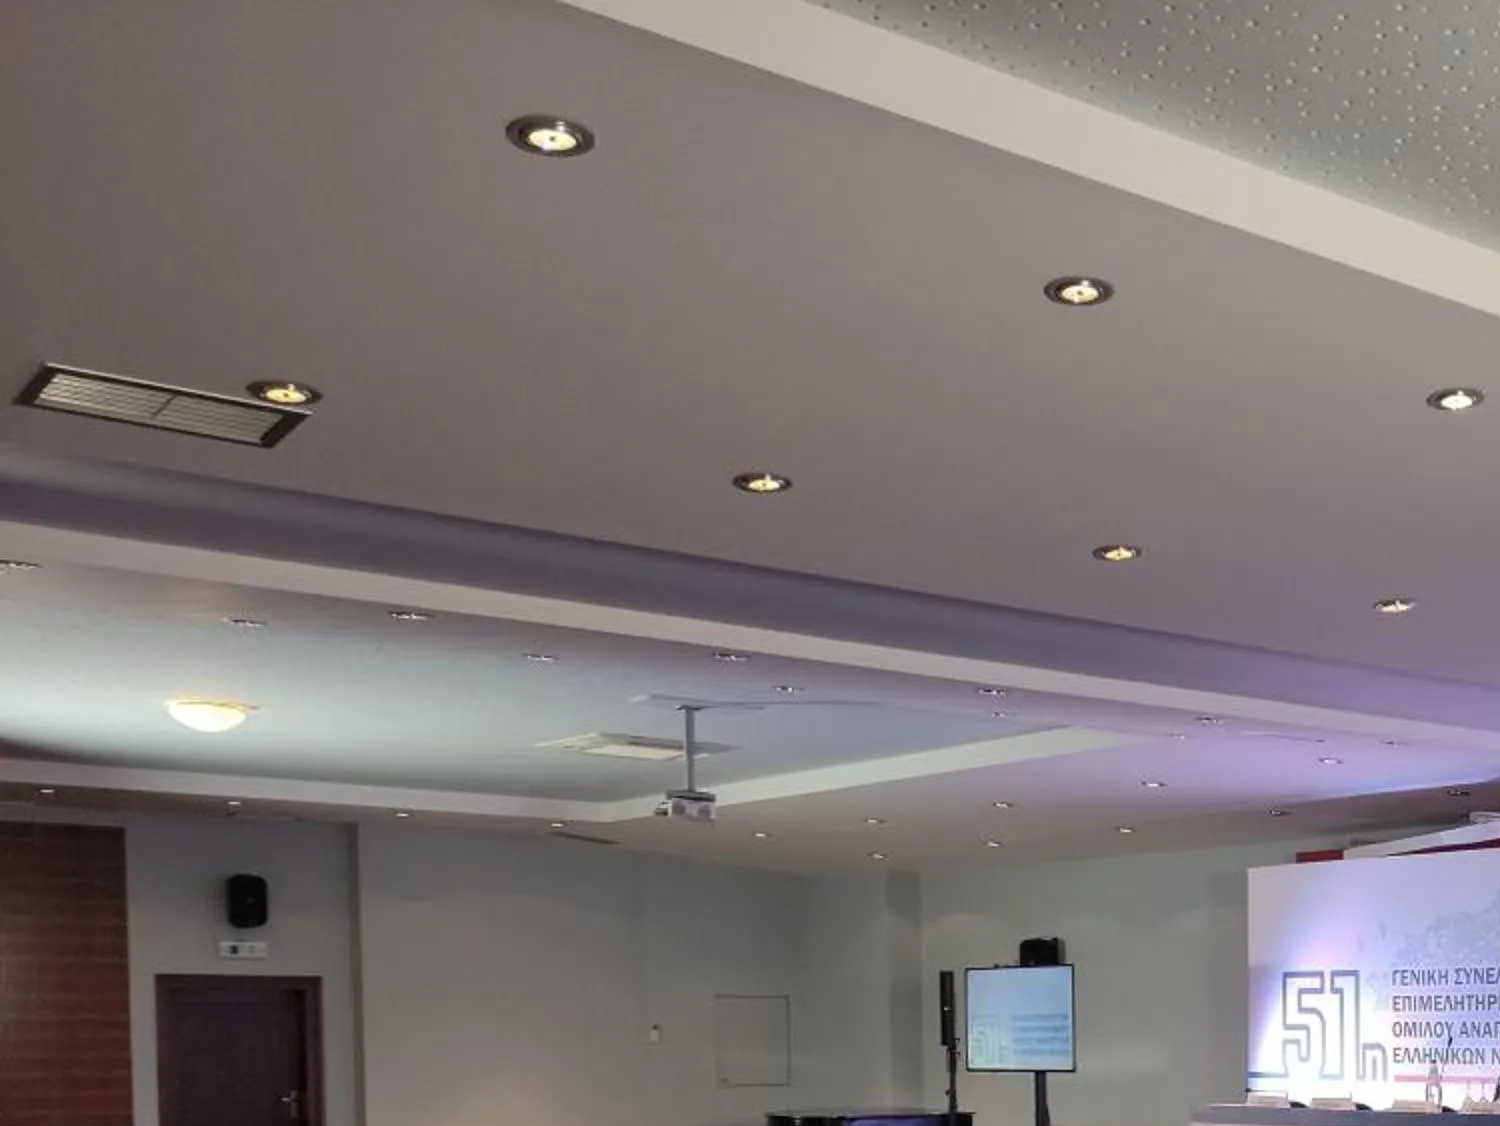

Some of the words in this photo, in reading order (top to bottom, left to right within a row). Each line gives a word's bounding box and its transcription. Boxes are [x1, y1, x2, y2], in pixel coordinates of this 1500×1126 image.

[1391, 969, 1449, 987] ΓΕΝΙΚΗ
[1391, 1020, 1452, 1039] ΟΜΙΛΟΥ
[1392, 1047, 1486, 1066] ΕΛΛΗΝΙΚΩΝ
